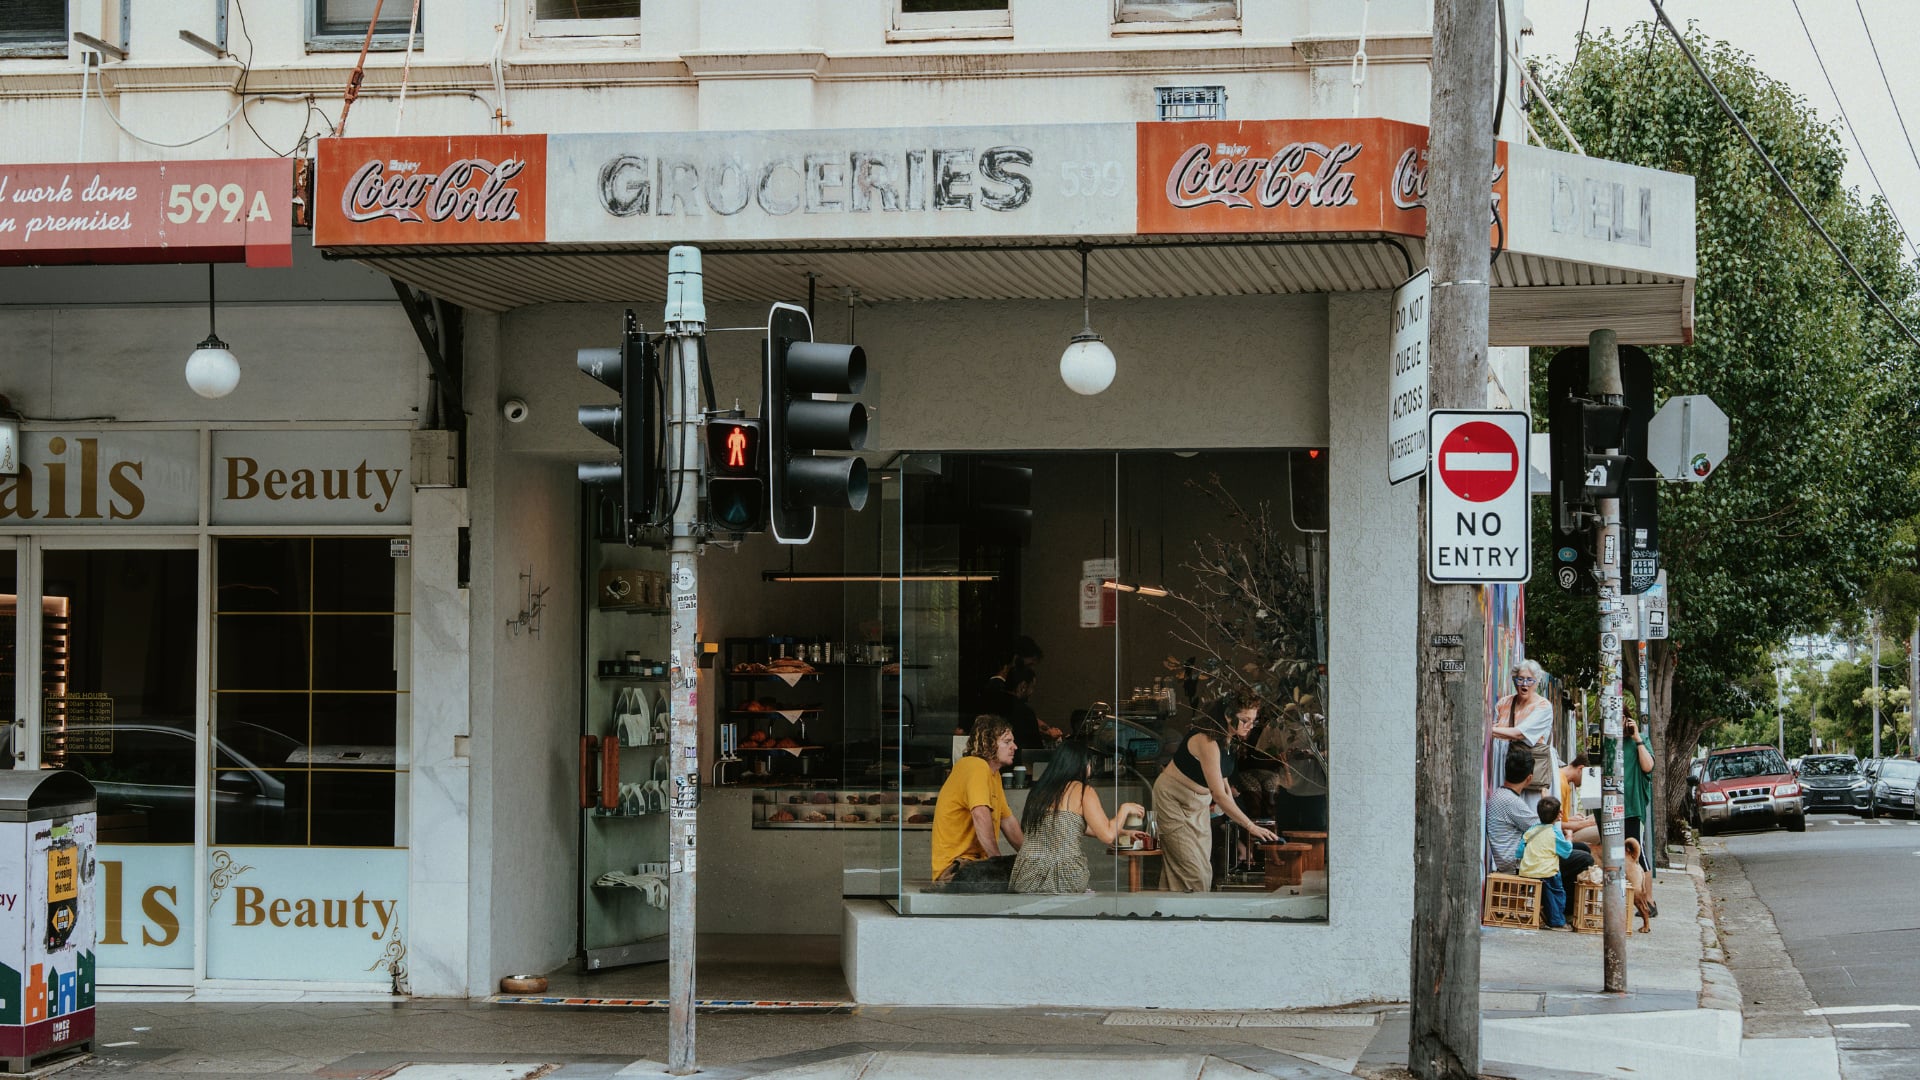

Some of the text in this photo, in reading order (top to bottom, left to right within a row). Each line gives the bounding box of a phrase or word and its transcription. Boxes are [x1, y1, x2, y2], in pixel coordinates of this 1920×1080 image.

[389, 159, 421, 174] Enjoy
[1216, 142, 1250, 158] Enjoy
[13, 174, 73, 203] work
[81, 174, 137, 202] done
[598, 145, 1034, 217] GROCERIES
[1060, 160, 1125, 199] 599
[1549, 171, 1653, 248] DELI
[0, 210, 132, 243] n premises
[1395, 295, 1424, 333] DO NOT
[1395, 340, 1422, 377] QUEUE
[1392, 385, 1423, 421] ACROSS
[1389, 431, 1426, 463] INTERSECTION
[222, 456, 403, 513] Beauty
[1456, 511, 1502, 537] NO
[1437, 546, 1520, 568] ENTRY
[56, 855, 71, 867] Before
[231, 885, 399, 941] Beauty
[52, 1029, 70, 1042] WEST
